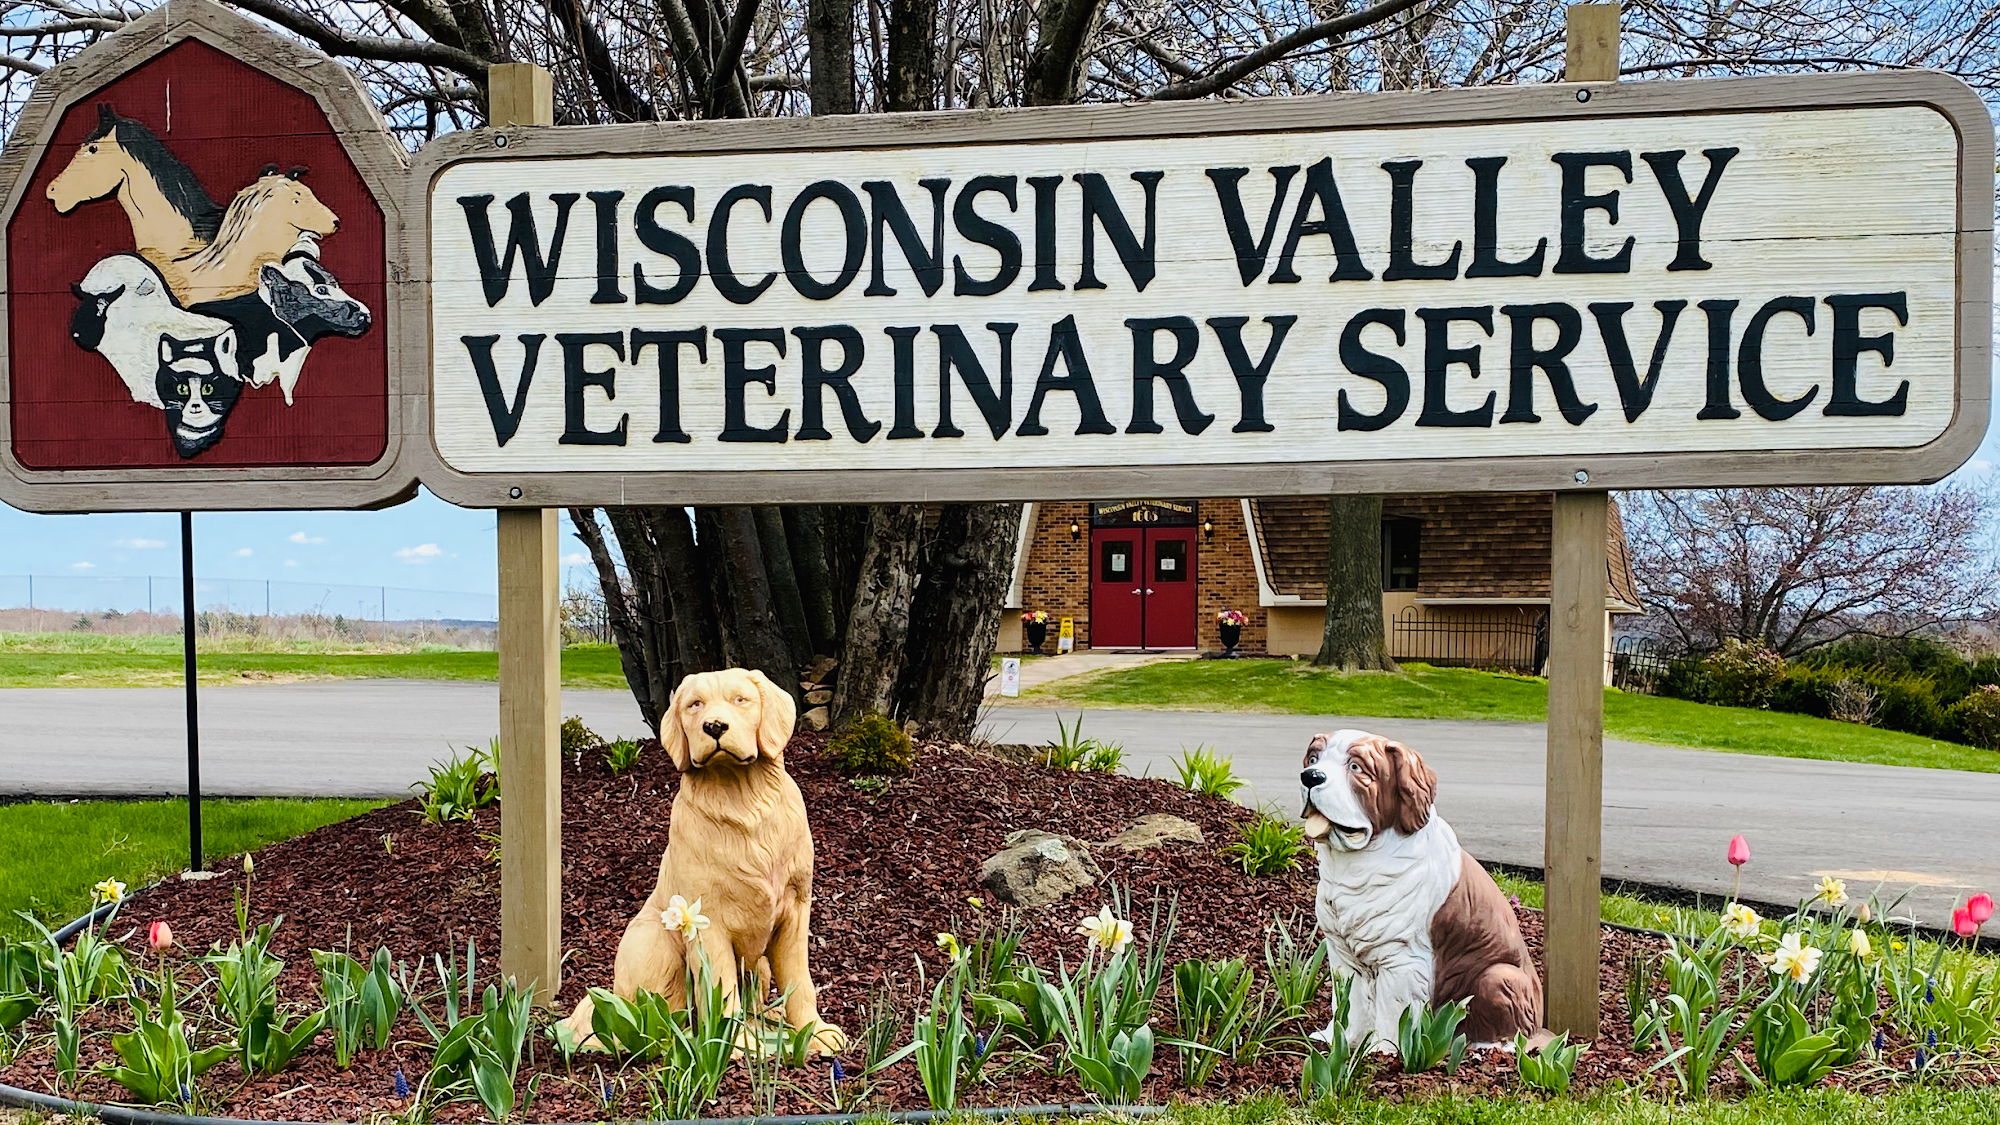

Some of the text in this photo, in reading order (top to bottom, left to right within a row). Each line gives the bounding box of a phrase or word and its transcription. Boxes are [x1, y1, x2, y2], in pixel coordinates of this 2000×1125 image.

[457, 146, 1740, 308] WISCONSIN VALLEY
[460, 291, 1910, 448] VETERINARY SERVICE
[1098, 504, 1125, 514] WISCONSIN
[1173, 503, 1192, 513] SERVICE
